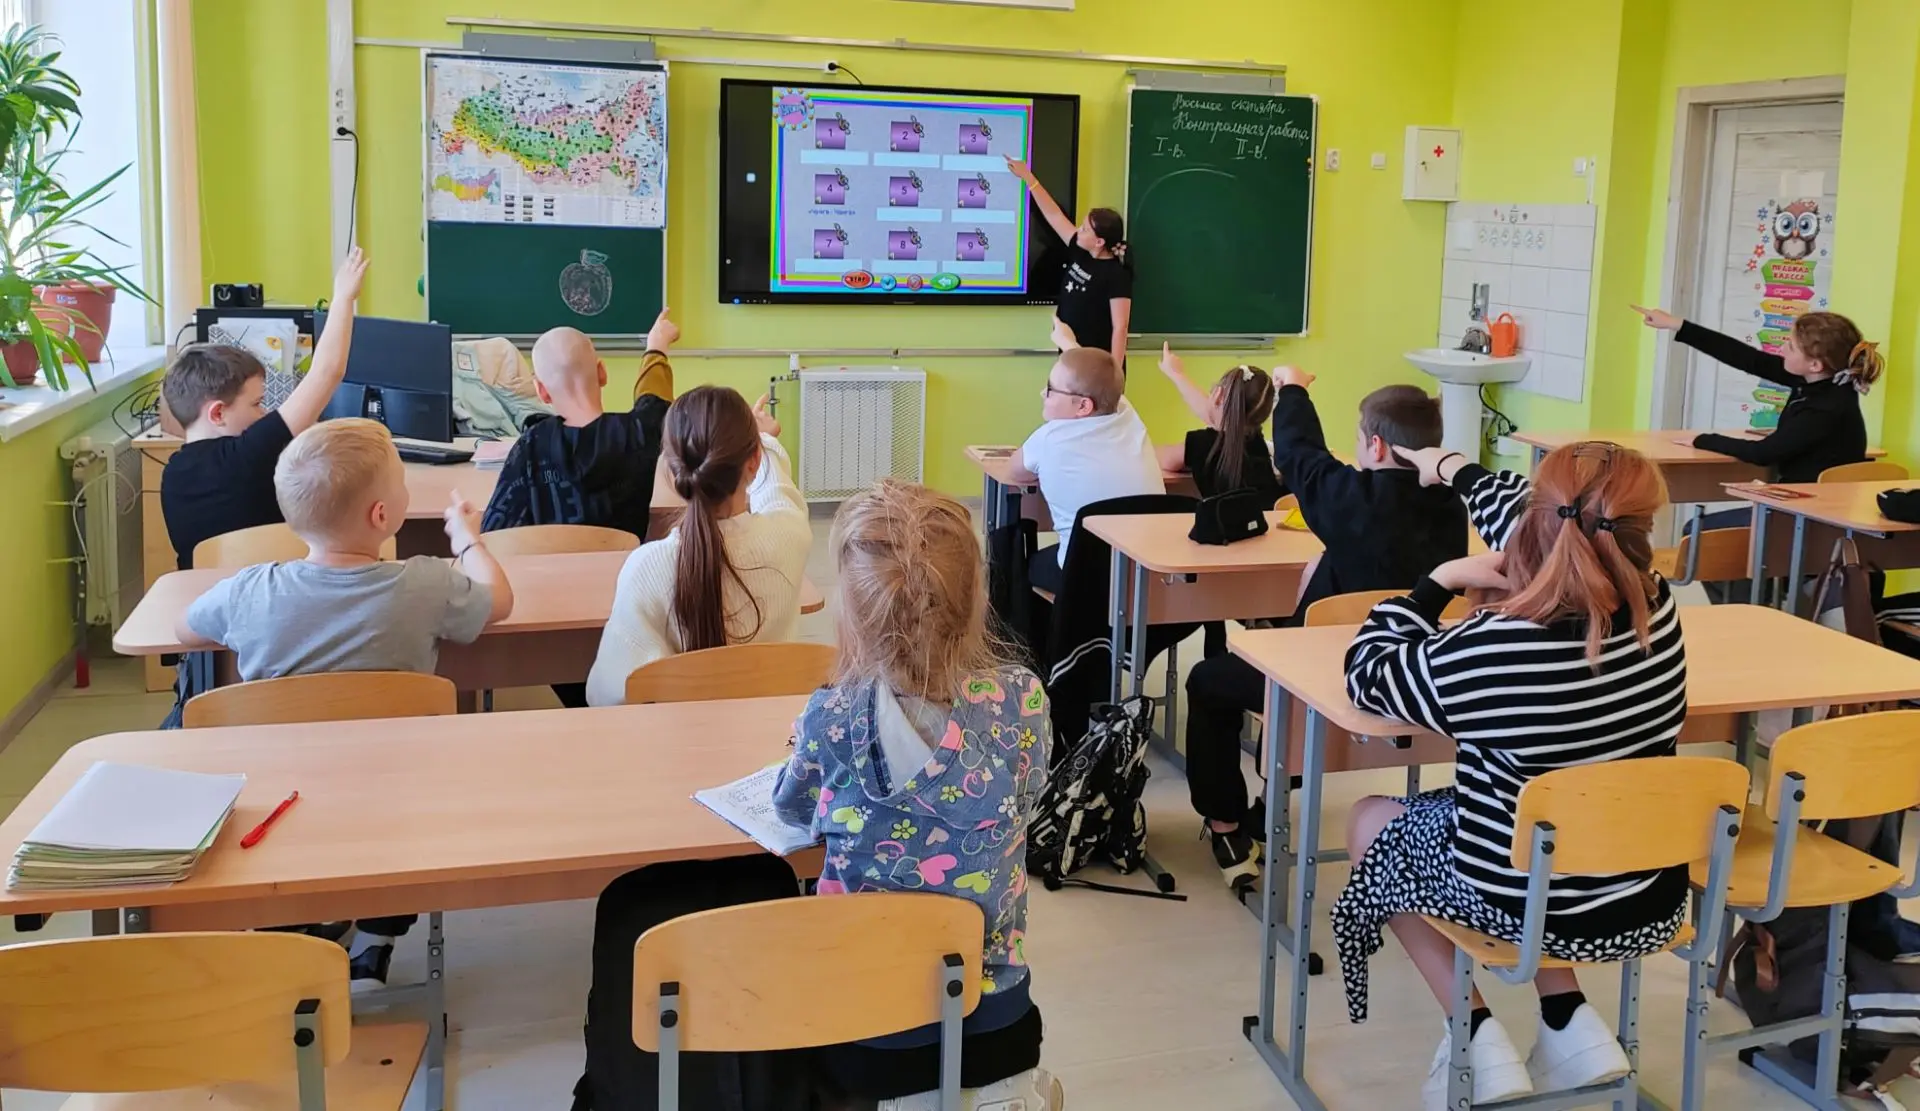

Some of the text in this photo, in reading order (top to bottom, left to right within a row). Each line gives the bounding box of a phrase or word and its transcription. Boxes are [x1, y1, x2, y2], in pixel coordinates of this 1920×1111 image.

[1172, 111, 1265, 143] Контрольная
[827, 128, 834, 137] 1
[902, 131, 909, 140] 2
[970, 133, 977, 142] 3
[826, 184, 833, 193] 4
[901, 186, 908, 195] 5
[969, 188, 976, 197] 6
[826, 239, 833, 248] 7
[900, 240, 907, 249] 8
[967, 241, 974, 250] 9
